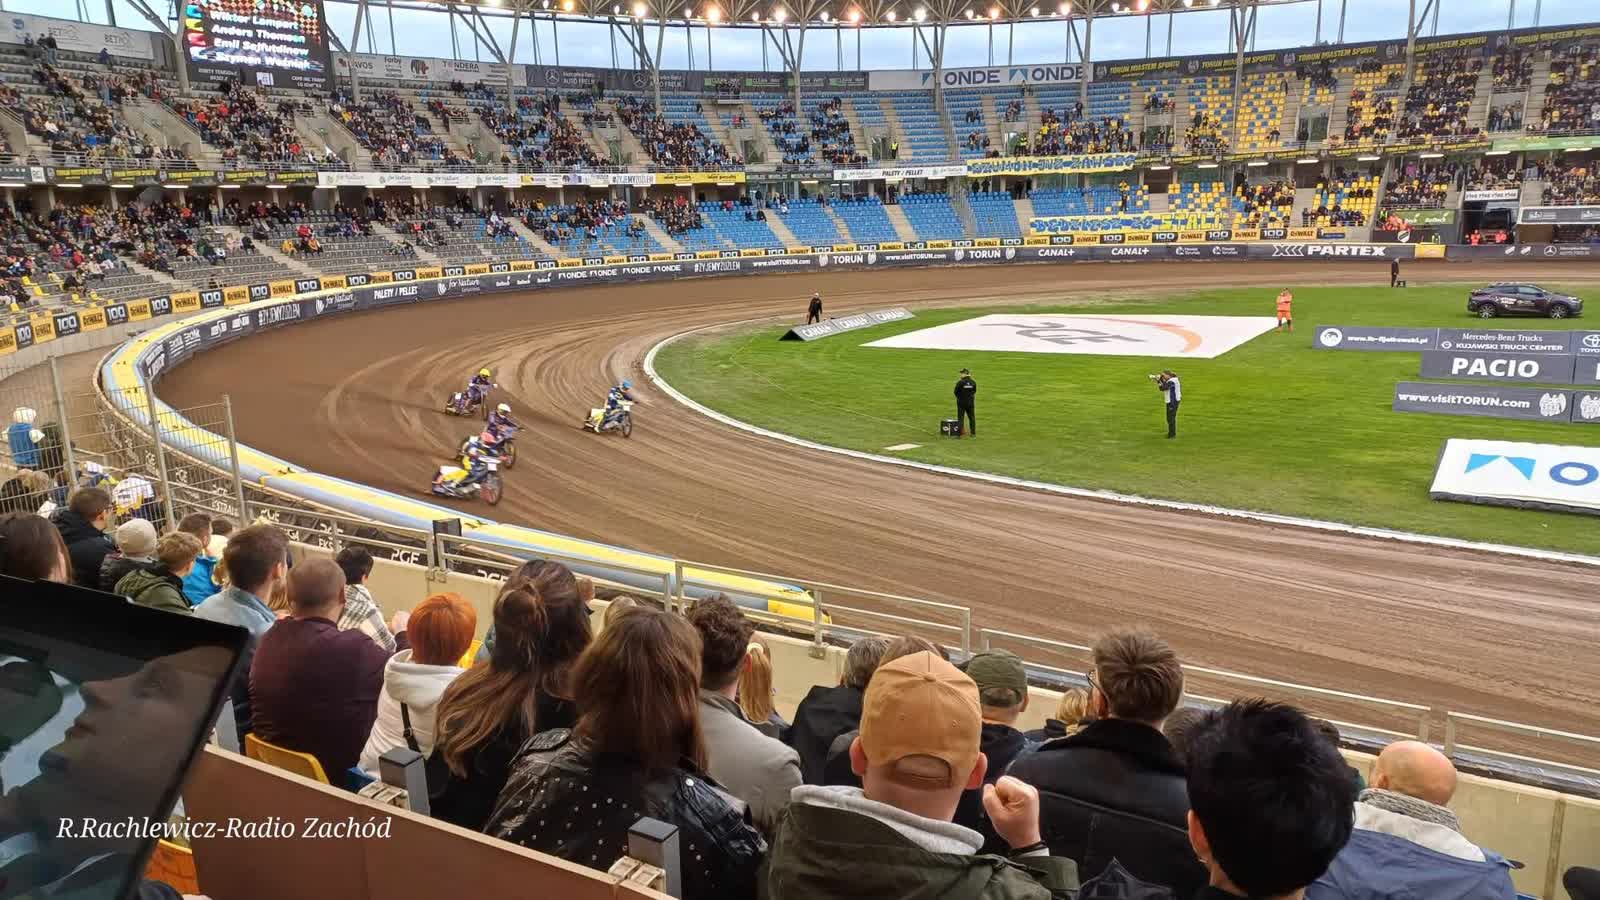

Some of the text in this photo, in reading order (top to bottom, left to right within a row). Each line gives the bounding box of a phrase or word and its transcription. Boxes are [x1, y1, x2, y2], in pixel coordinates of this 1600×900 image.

[944, 70, 1001, 86] ONDE
[1031, 66, 1084, 81] ONDE
[1053, 236, 1071, 244] 100
[1038, 248, 1075, 257] CANAL+
[1111, 247, 1149, 256] CANAL+
[1307, 245, 1386, 257] PARTEX
[445, 268, 463, 276] 100
[492, 264, 507, 272] 100
[630, 266, 651, 274] ONDE
[348, 275, 367, 285] 100
[394, 271, 413, 280] 100
[567, 270, 587, 279] ONDE
[298, 280, 317, 290] 100
[202, 291, 221, 302] 100
[251, 285, 268, 297] 100
[373, 288, 394, 300] PALETY
[152, 298, 169, 312] 100
[107, 306, 126, 320] 100
[57, 315, 77, 331] 100
[16, 326, 31, 342] 100
[1518, 334, 1543, 342] Trucks
[1451, 357, 1540, 378] PACIO
[1398, 392, 1531, 409] www.visitTORUN.com
